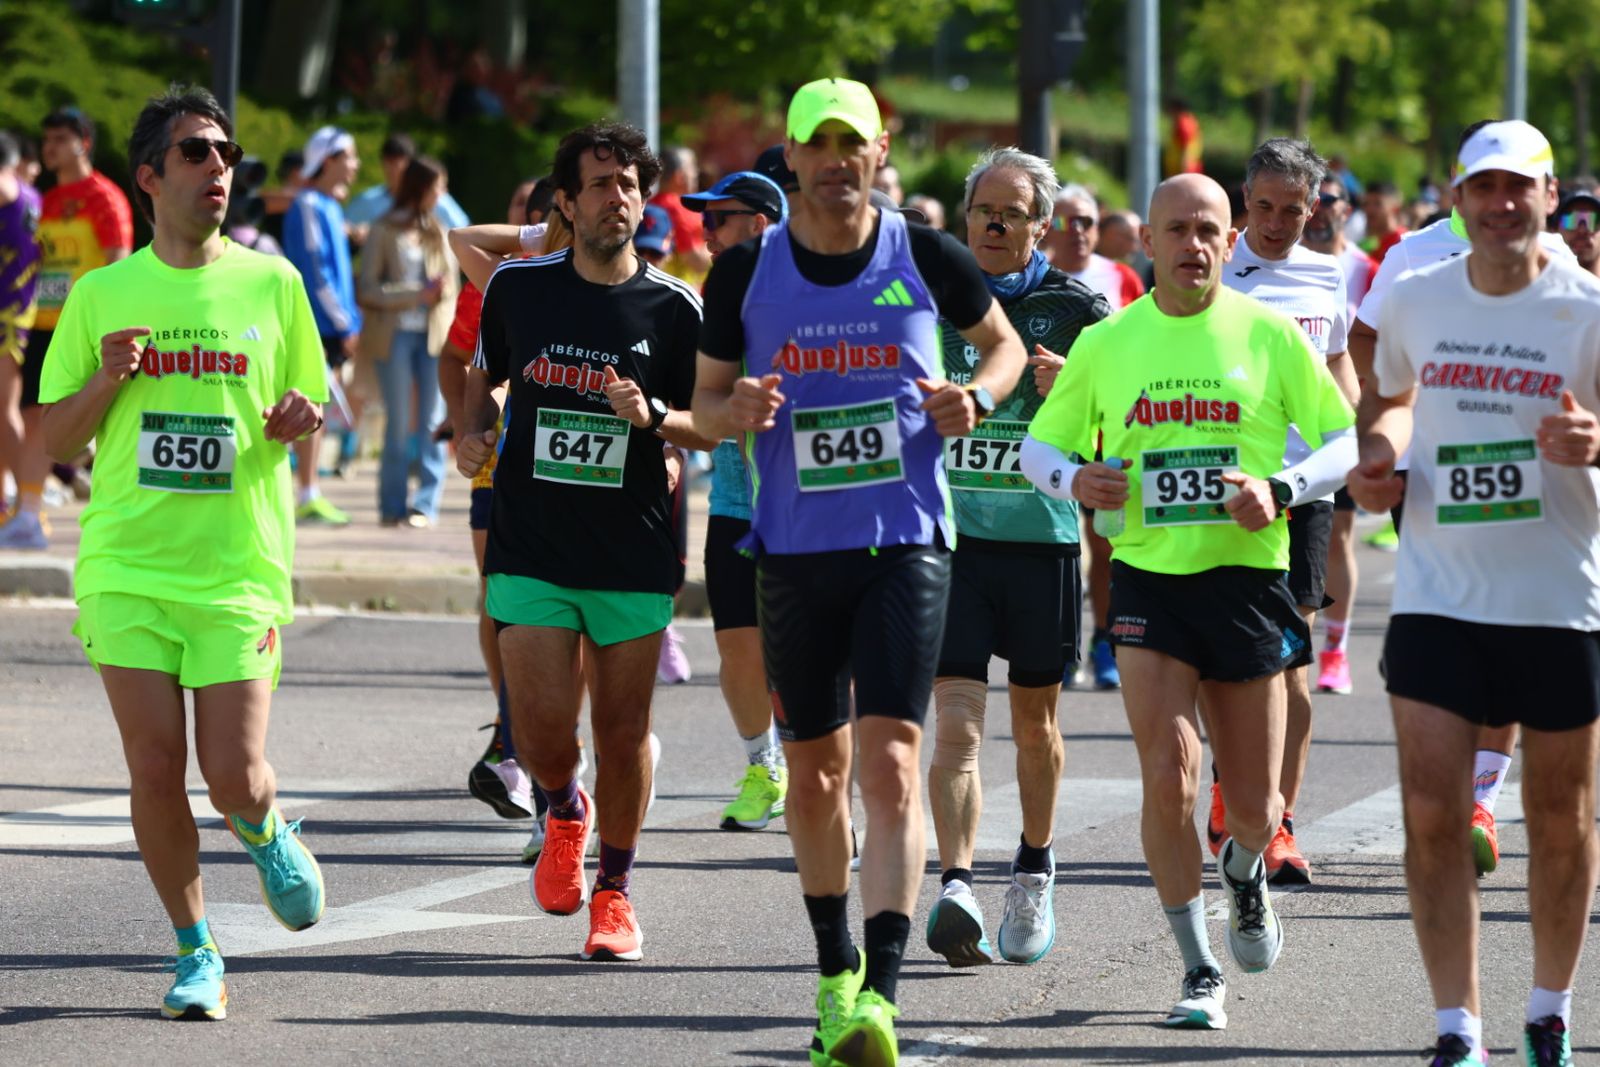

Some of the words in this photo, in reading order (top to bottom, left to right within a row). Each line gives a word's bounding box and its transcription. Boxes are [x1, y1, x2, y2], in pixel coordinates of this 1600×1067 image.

[155, 327, 229, 341] IBÉRICOS
[797, 322, 879, 338] IBÉRICOS
[142, 343, 249, 380] Quejusa
[550, 343, 620, 365] IBÉRICOS
[783, 340, 900, 378] Quejusa
[533, 355, 609, 396] Queju
[1149, 378, 1222, 391] IBÉRICOS
[1420, 360, 1564, 400] CARNICER
[562, 421, 604, 431] CARRERA
[1136, 392, 1241, 428] Quejusa
[166, 422, 212, 433] CARRERA
[971, 428, 1012, 438] CARRERA
[152, 434, 221, 470] 650
[549, 431, 613, 465] 647
[811, 426, 883, 466] 649
[950, 437, 1022, 472] 1572
[1157, 469, 1225, 503] 935
[1450, 464, 1523, 502] 859
